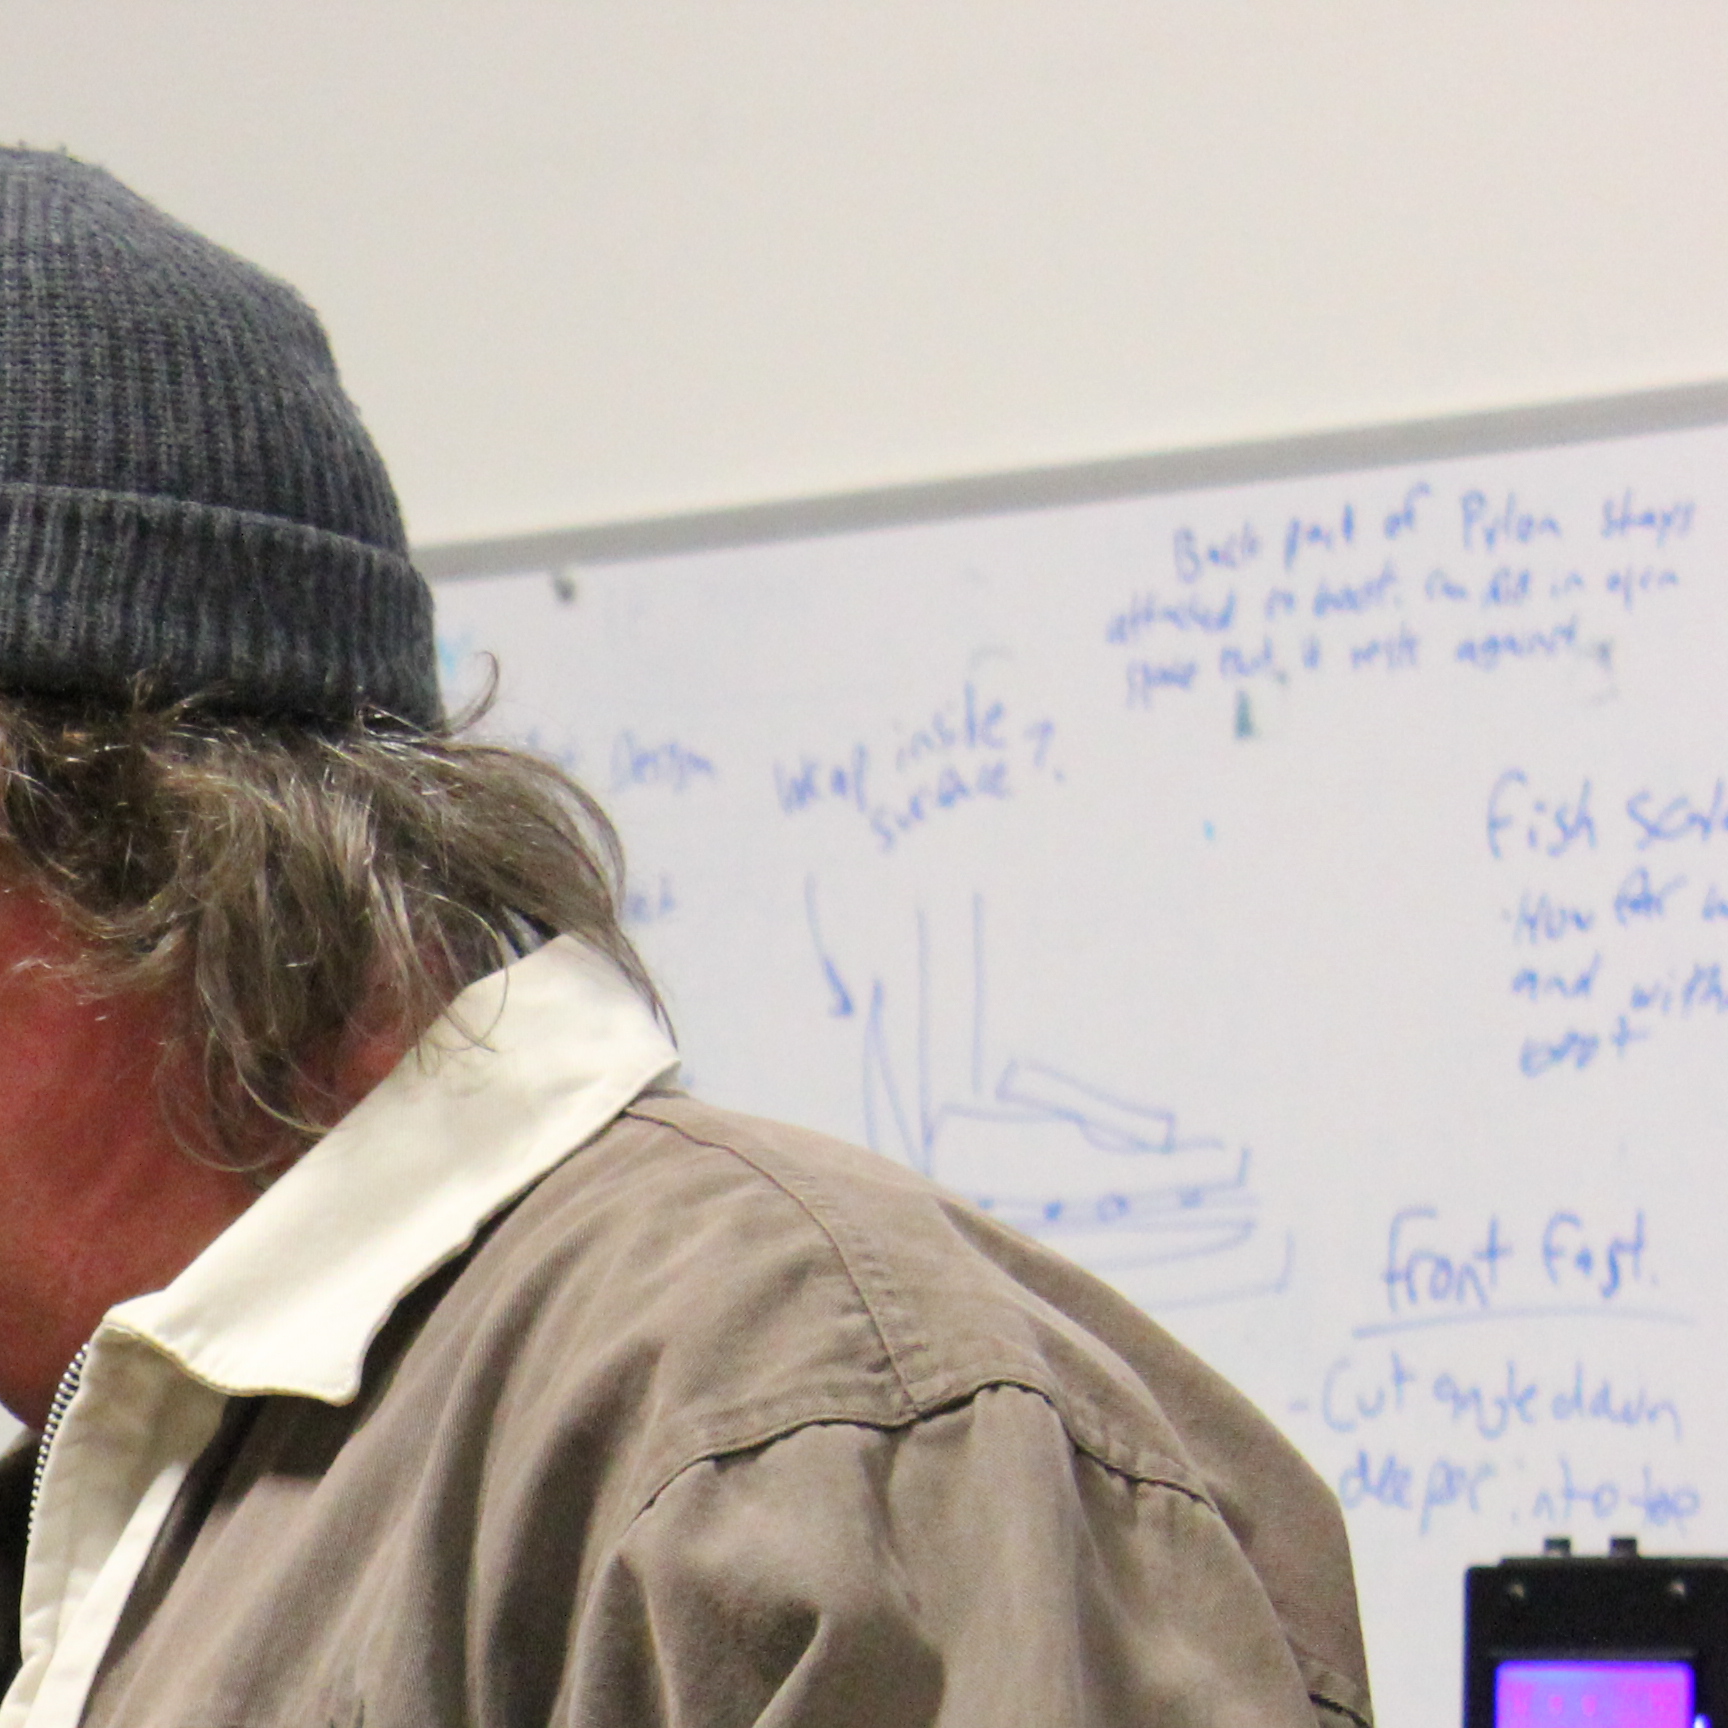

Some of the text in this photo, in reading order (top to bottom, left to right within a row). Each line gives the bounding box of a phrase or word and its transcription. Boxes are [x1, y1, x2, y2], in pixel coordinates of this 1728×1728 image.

[1384, 480, 1432, 540] of
[1486, 766, 1728, 861] Fish Scal
